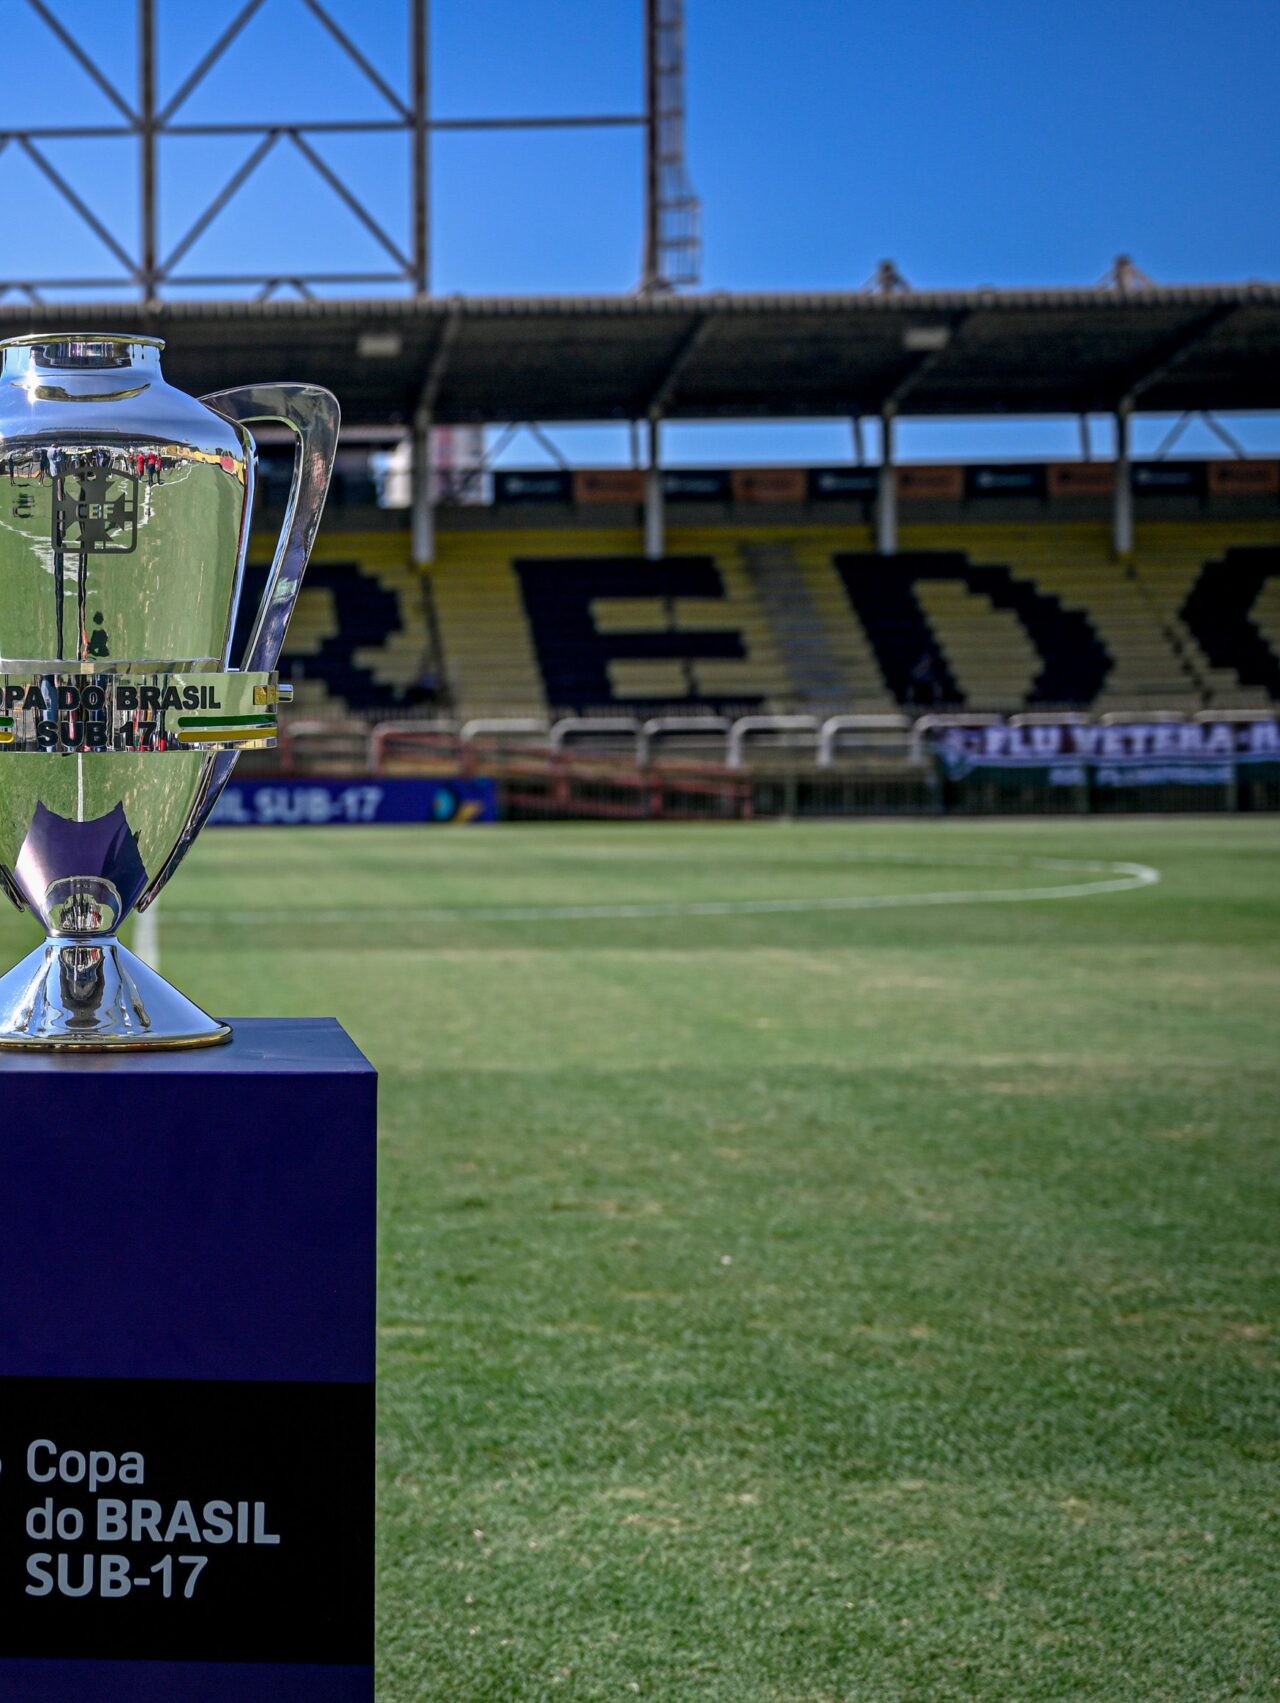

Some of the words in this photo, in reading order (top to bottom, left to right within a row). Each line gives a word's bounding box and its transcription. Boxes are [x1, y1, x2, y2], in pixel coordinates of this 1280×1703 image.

[76, 503, 115, 520] CBF
[58, 685, 106, 711] DO
[116, 685, 221, 711] BRASIL
[36, 720, 108, 748] SUB
[253, 785, 385, 824] SUB-17
[26, 1438, 145, 1492] Copa
[25, 1497, 85, 1541] do
[96, 1498, 281, 1545] BRASIL
[24, 1552, 209, 1599] SUB-17
